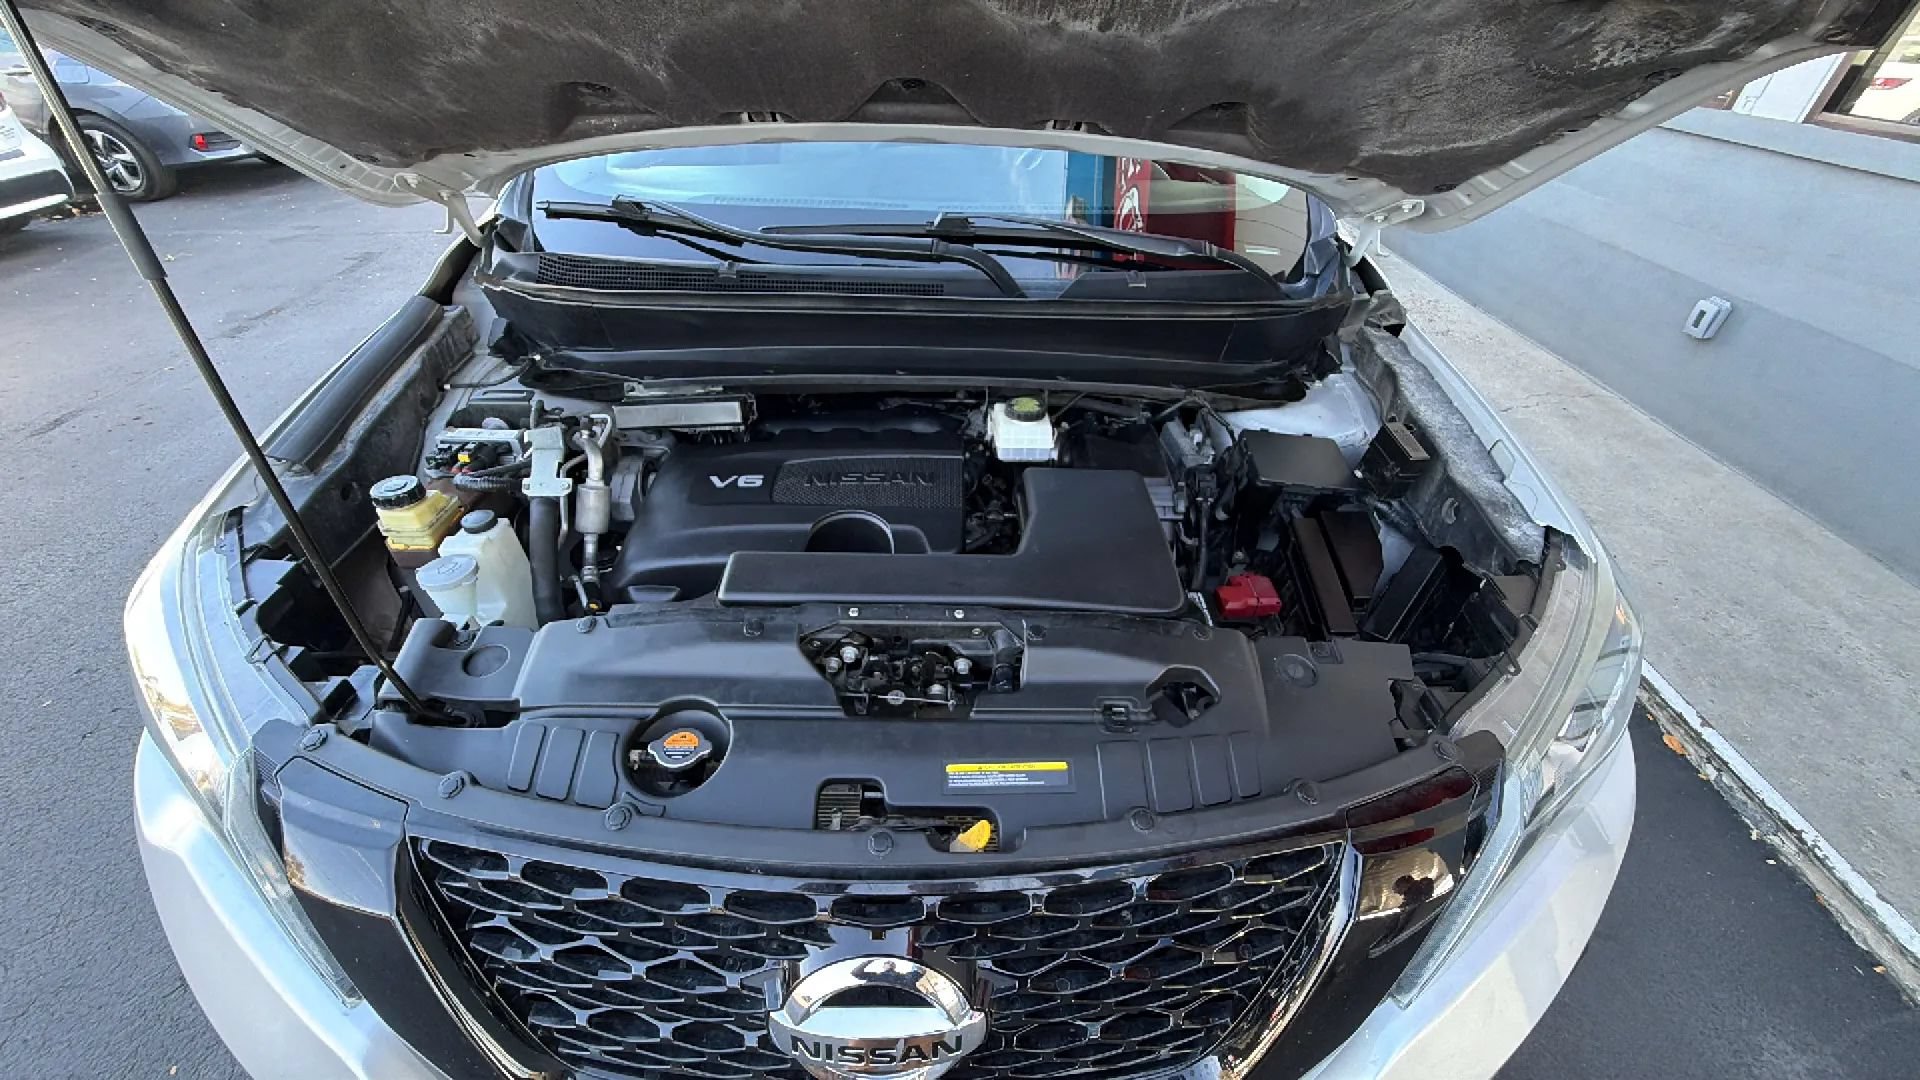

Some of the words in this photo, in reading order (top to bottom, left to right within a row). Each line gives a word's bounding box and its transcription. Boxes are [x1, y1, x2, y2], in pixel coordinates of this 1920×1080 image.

[709, 474, 764, 488] V6
[804, 472, 934, 487] NISSAN
[790, 1034, 963, 1065] NISSAN
